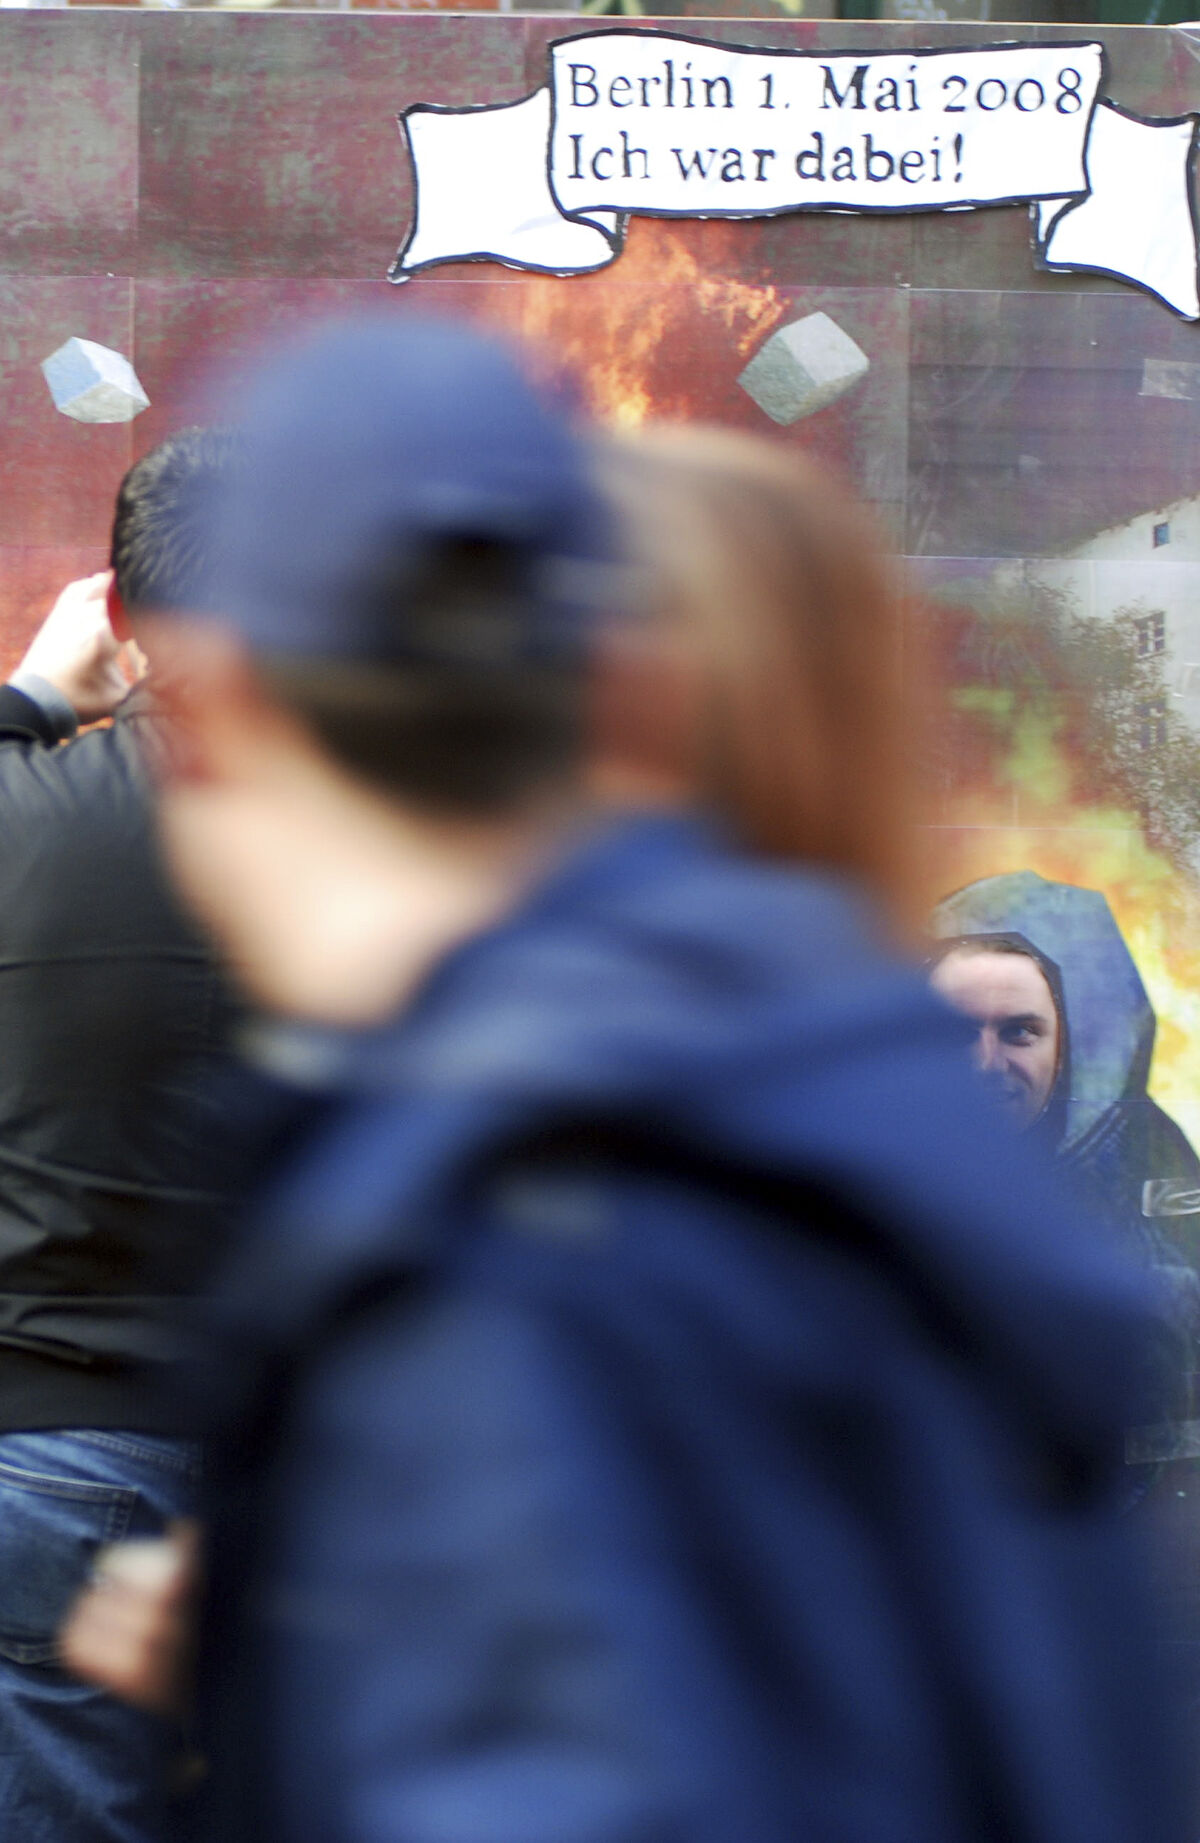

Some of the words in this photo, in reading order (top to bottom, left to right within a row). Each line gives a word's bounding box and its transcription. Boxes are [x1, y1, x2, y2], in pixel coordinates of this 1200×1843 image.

[567, 59, 734, 108] Berlin
[758, 73, 791, 110] 1.
[818, 63, 921, 112] Mai
[941, 66, 1083, 115] 2008
[567, 130, 651, 181] Ich
[669, 147, 777, 183] war
[794, 131, 964, 184] dabei!
